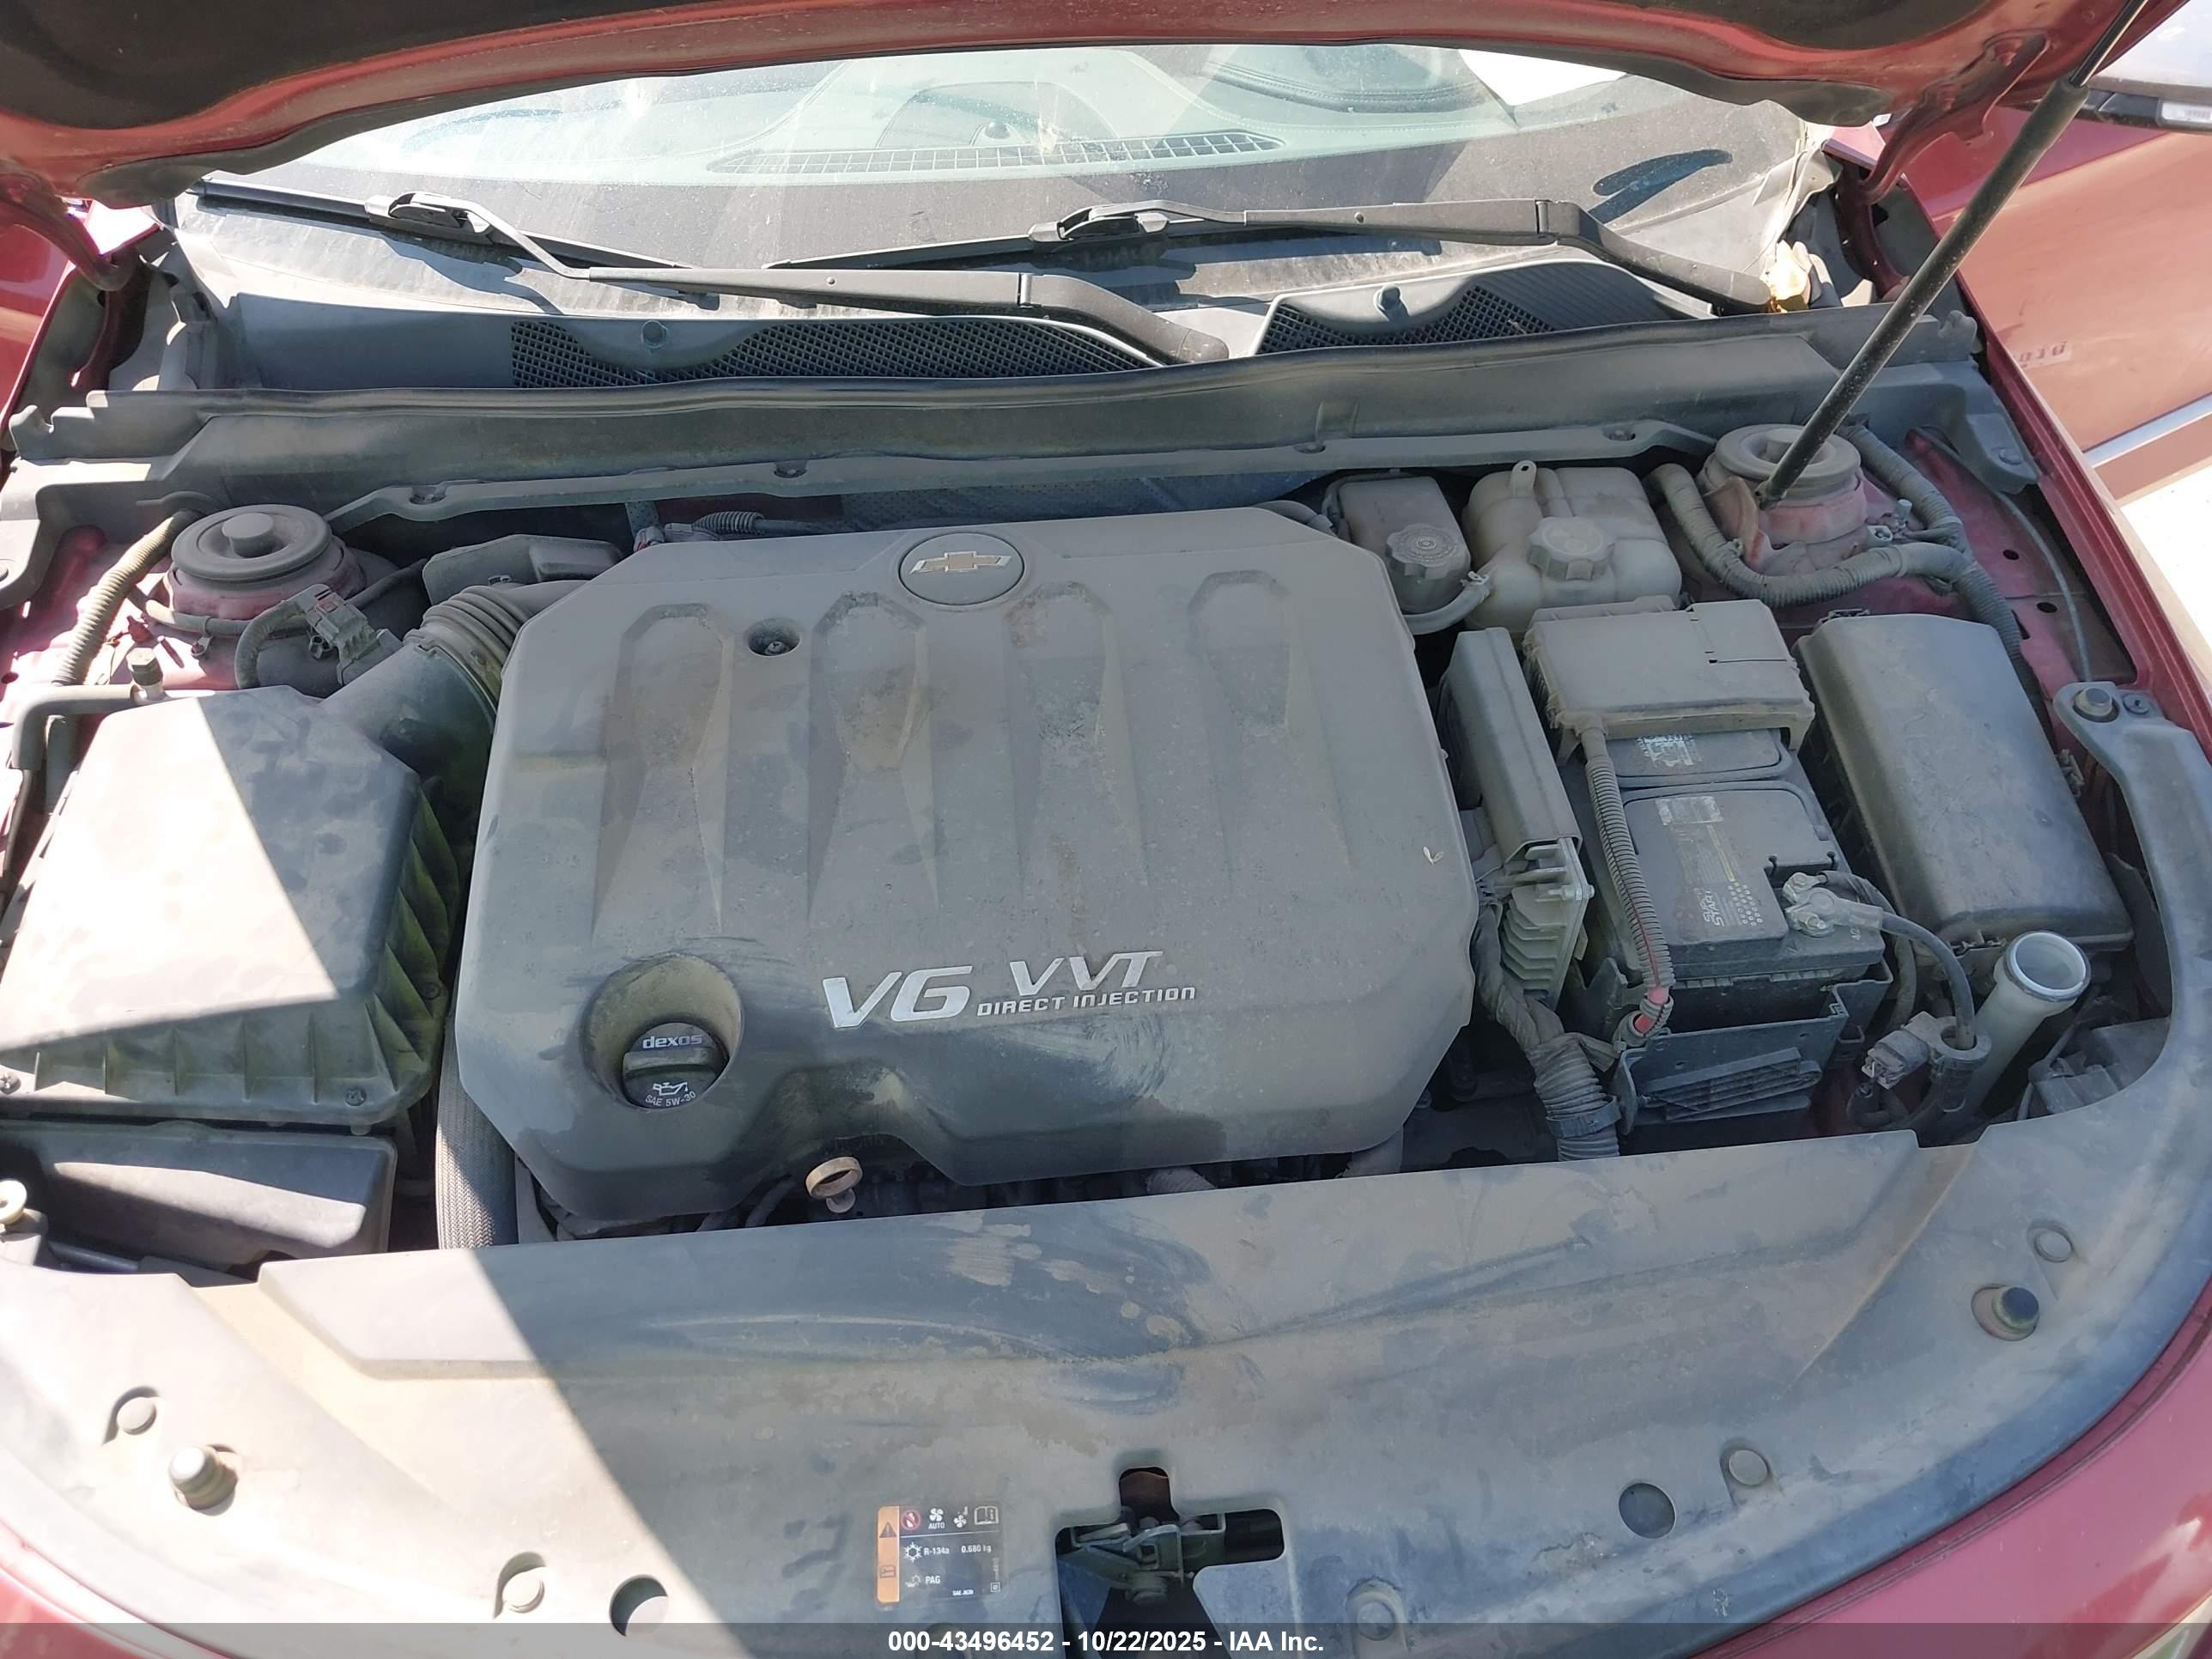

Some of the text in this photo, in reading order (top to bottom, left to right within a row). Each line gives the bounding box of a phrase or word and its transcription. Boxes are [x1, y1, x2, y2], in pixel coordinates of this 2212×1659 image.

[823, 951, 1164, 1029] V6 VVT
[977, 987, 1195, 1016] DIRECT INJECTION
[642, 1035, 704, 1049] dexos
[645, 1091, 696, 1107] SAE 5W-30
[923, 1547, 950, 1556] R-134a
[925, 1575, 941, 1585] PAG
